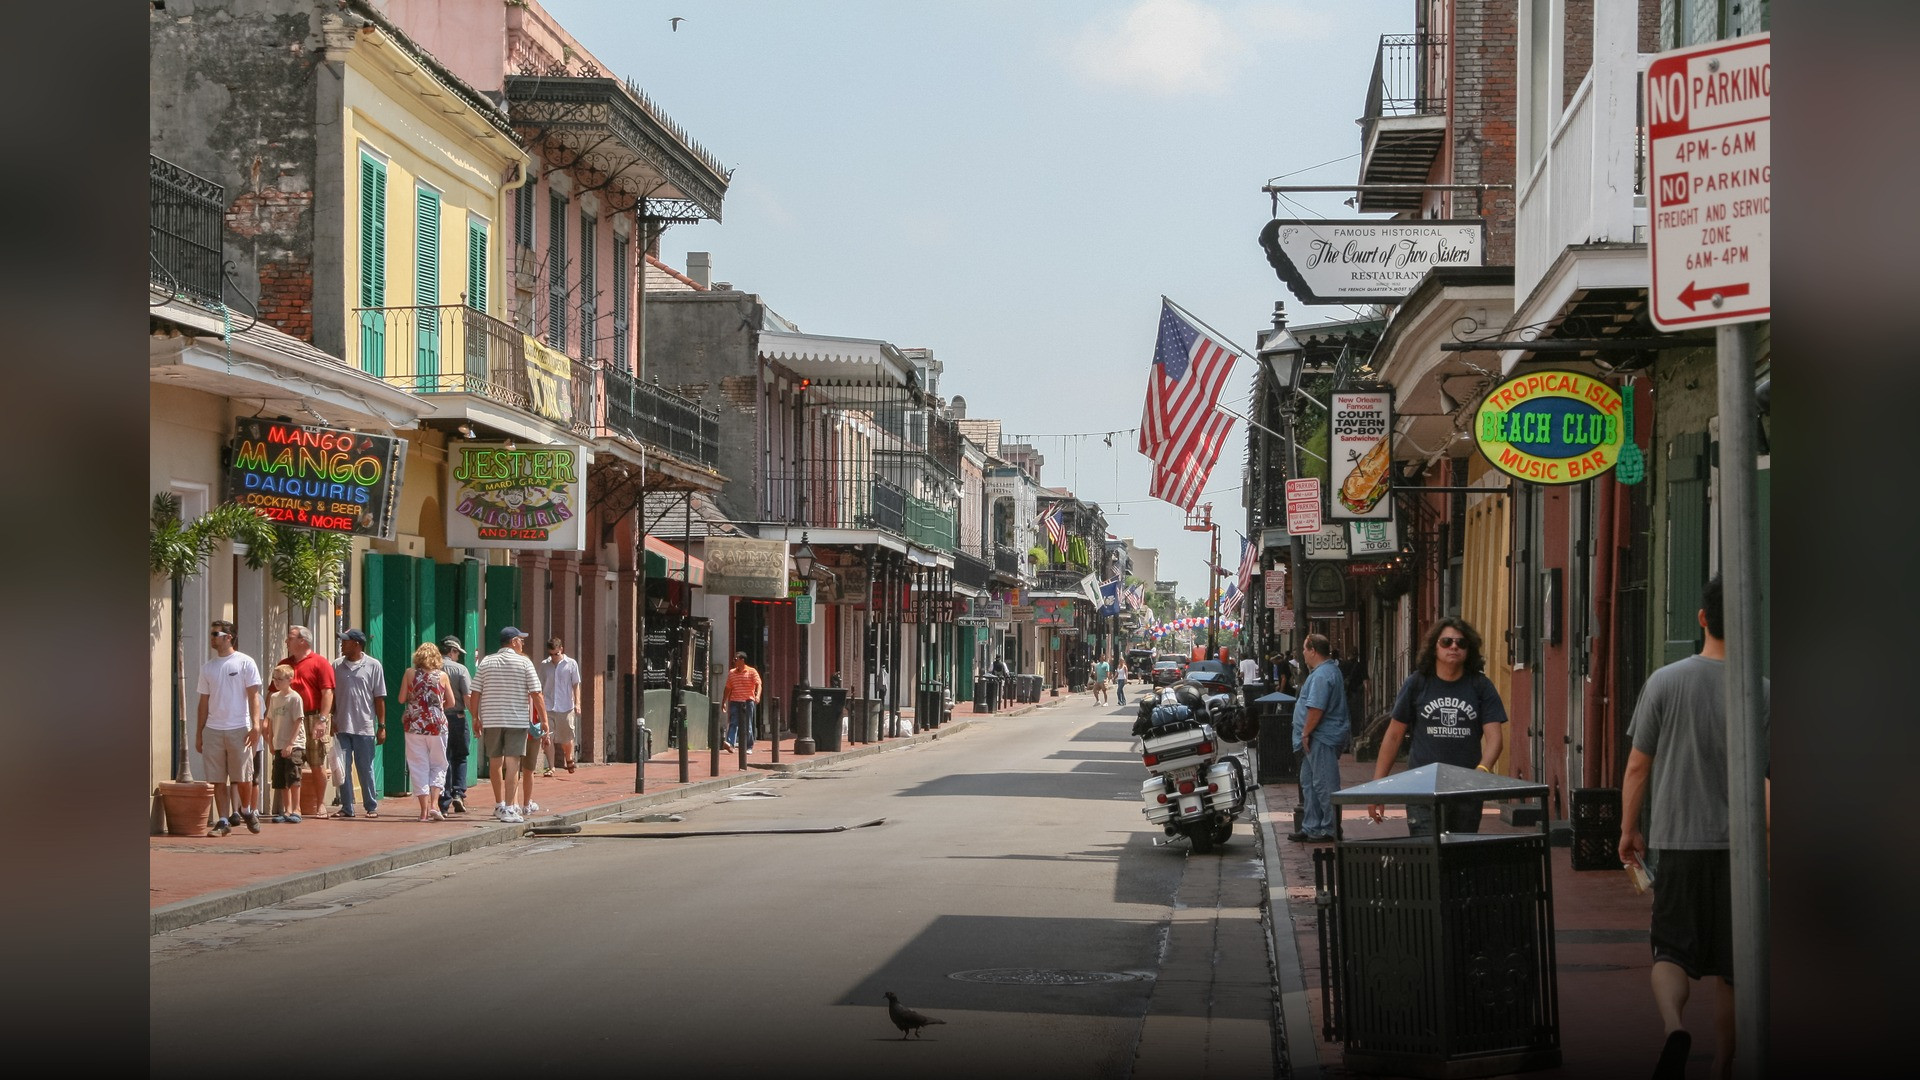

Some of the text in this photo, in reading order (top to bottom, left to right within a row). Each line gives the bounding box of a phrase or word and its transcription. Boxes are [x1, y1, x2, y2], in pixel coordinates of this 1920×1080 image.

[1650, 72, 1685, 125] NO
[1662, 176, 1686, 202] NO
[1658, 208, 1698, 229] FREIGHT
[1706, 204, 1726, 222] AND
[1334, 229, 1442, 237] FAMOUS HISTORICAL
[1702, 226, 1731, 246] ZONE
[1306, 237, 1471, 270] The Court of Two Sisters
[1351, 271, 1426, 280] RESTAURANT
[1489, 375, 1622, 415] TROPICAL ISLE
[1335, 419, 1385, 427] TAVERN
[1338, 411, 1383, 419] COURT
[267, 425, 354, 452] MANGO
[1335, 427, 1385, 435] PO-BOY
[1481, 411, 1618, 445] BEACH CLUB
[236, 440, 382, 486] MANGO
[454, 447, 578, 484] JESTER
[1499, 448, 1608, 480] MUSIC BAR
[245, 473, 370, 503] DAIQUIRIS
[485, 478, 548, 491] MARDI GRAS
[1295, 482, 1317, 490] PARKING
[247, 493, 362, 515] COCKTAILS & BEER
[458, 501, 571, 528] DAIQUIRIS
[1297, 502, 1318, 510] PARKING
[255, 507, 353, 530] PIZZA & MORE
[479, 529, 546, 539] AND PIZZA
[1377, 541, 1391, 549] GO!
[1421, 697, 1478, 721] LONGBOARD
[1426, 726, 1471, 736] INSTRUCTOR
